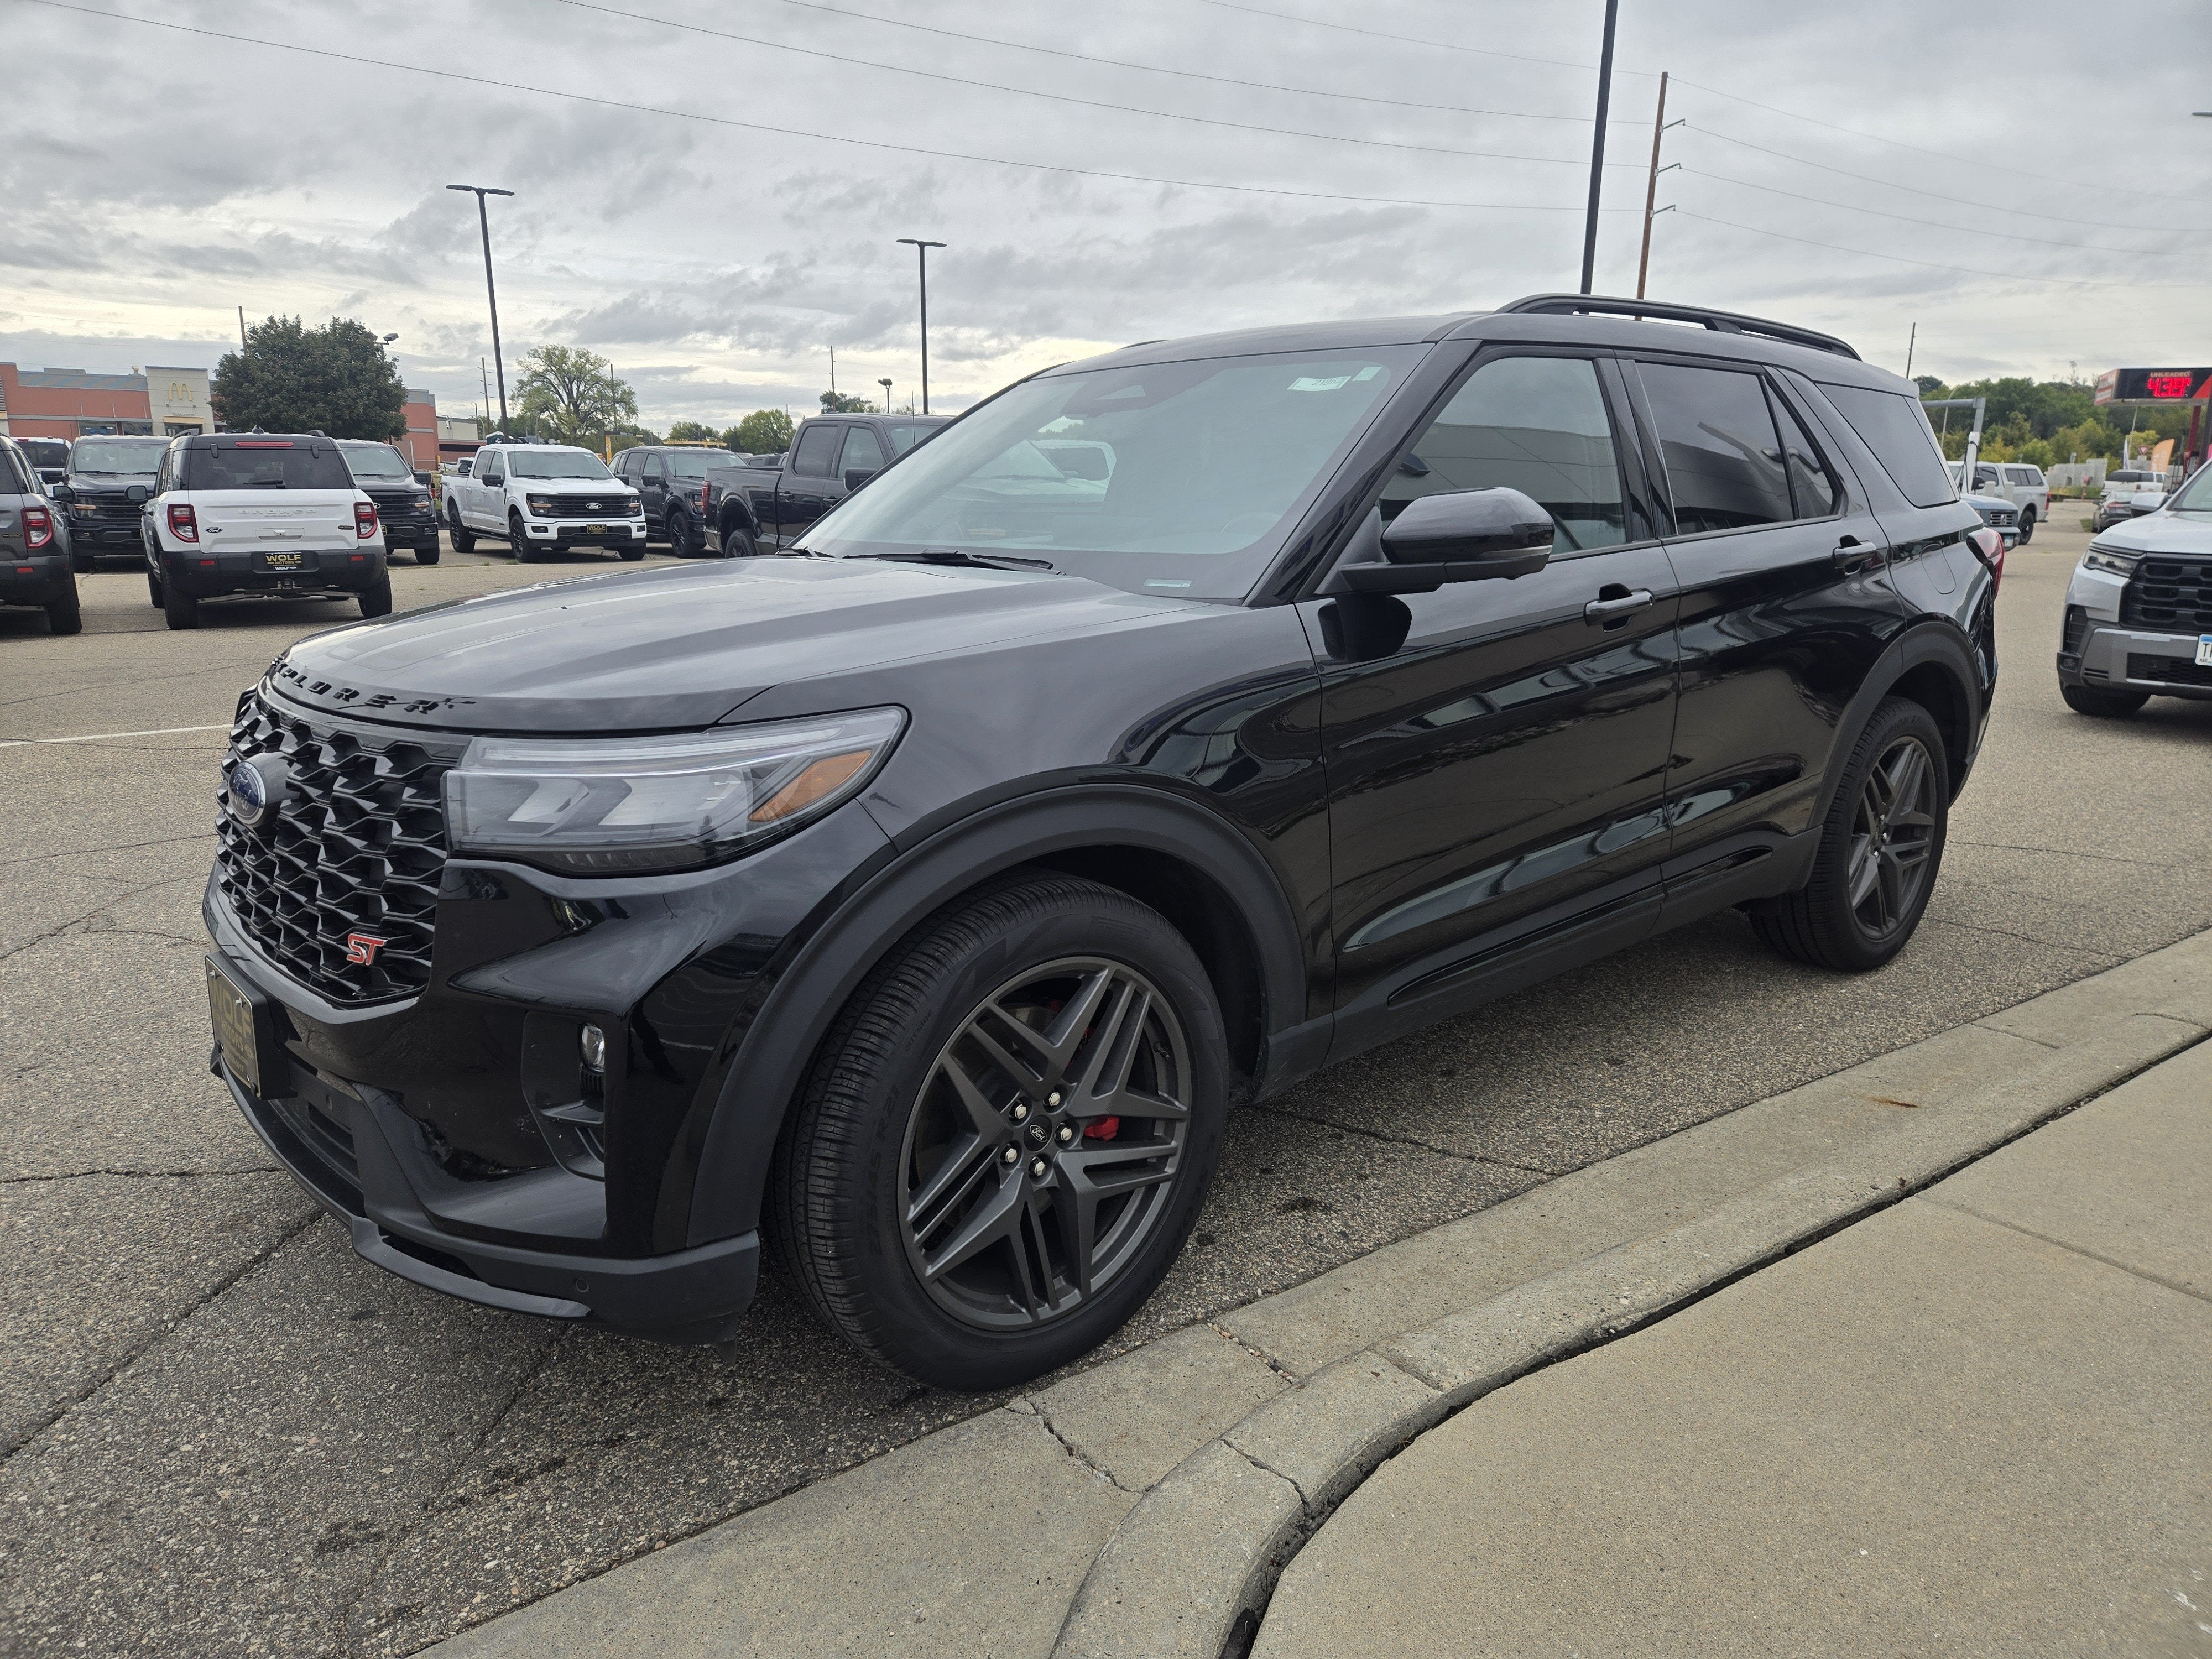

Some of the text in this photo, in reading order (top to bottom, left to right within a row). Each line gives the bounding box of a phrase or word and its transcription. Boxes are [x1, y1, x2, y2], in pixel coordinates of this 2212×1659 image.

[346, 932, 389, 966] ST
[210, 976, 251, 1039] WOLF
[1031, 1127, 1046, 1140] Ford
